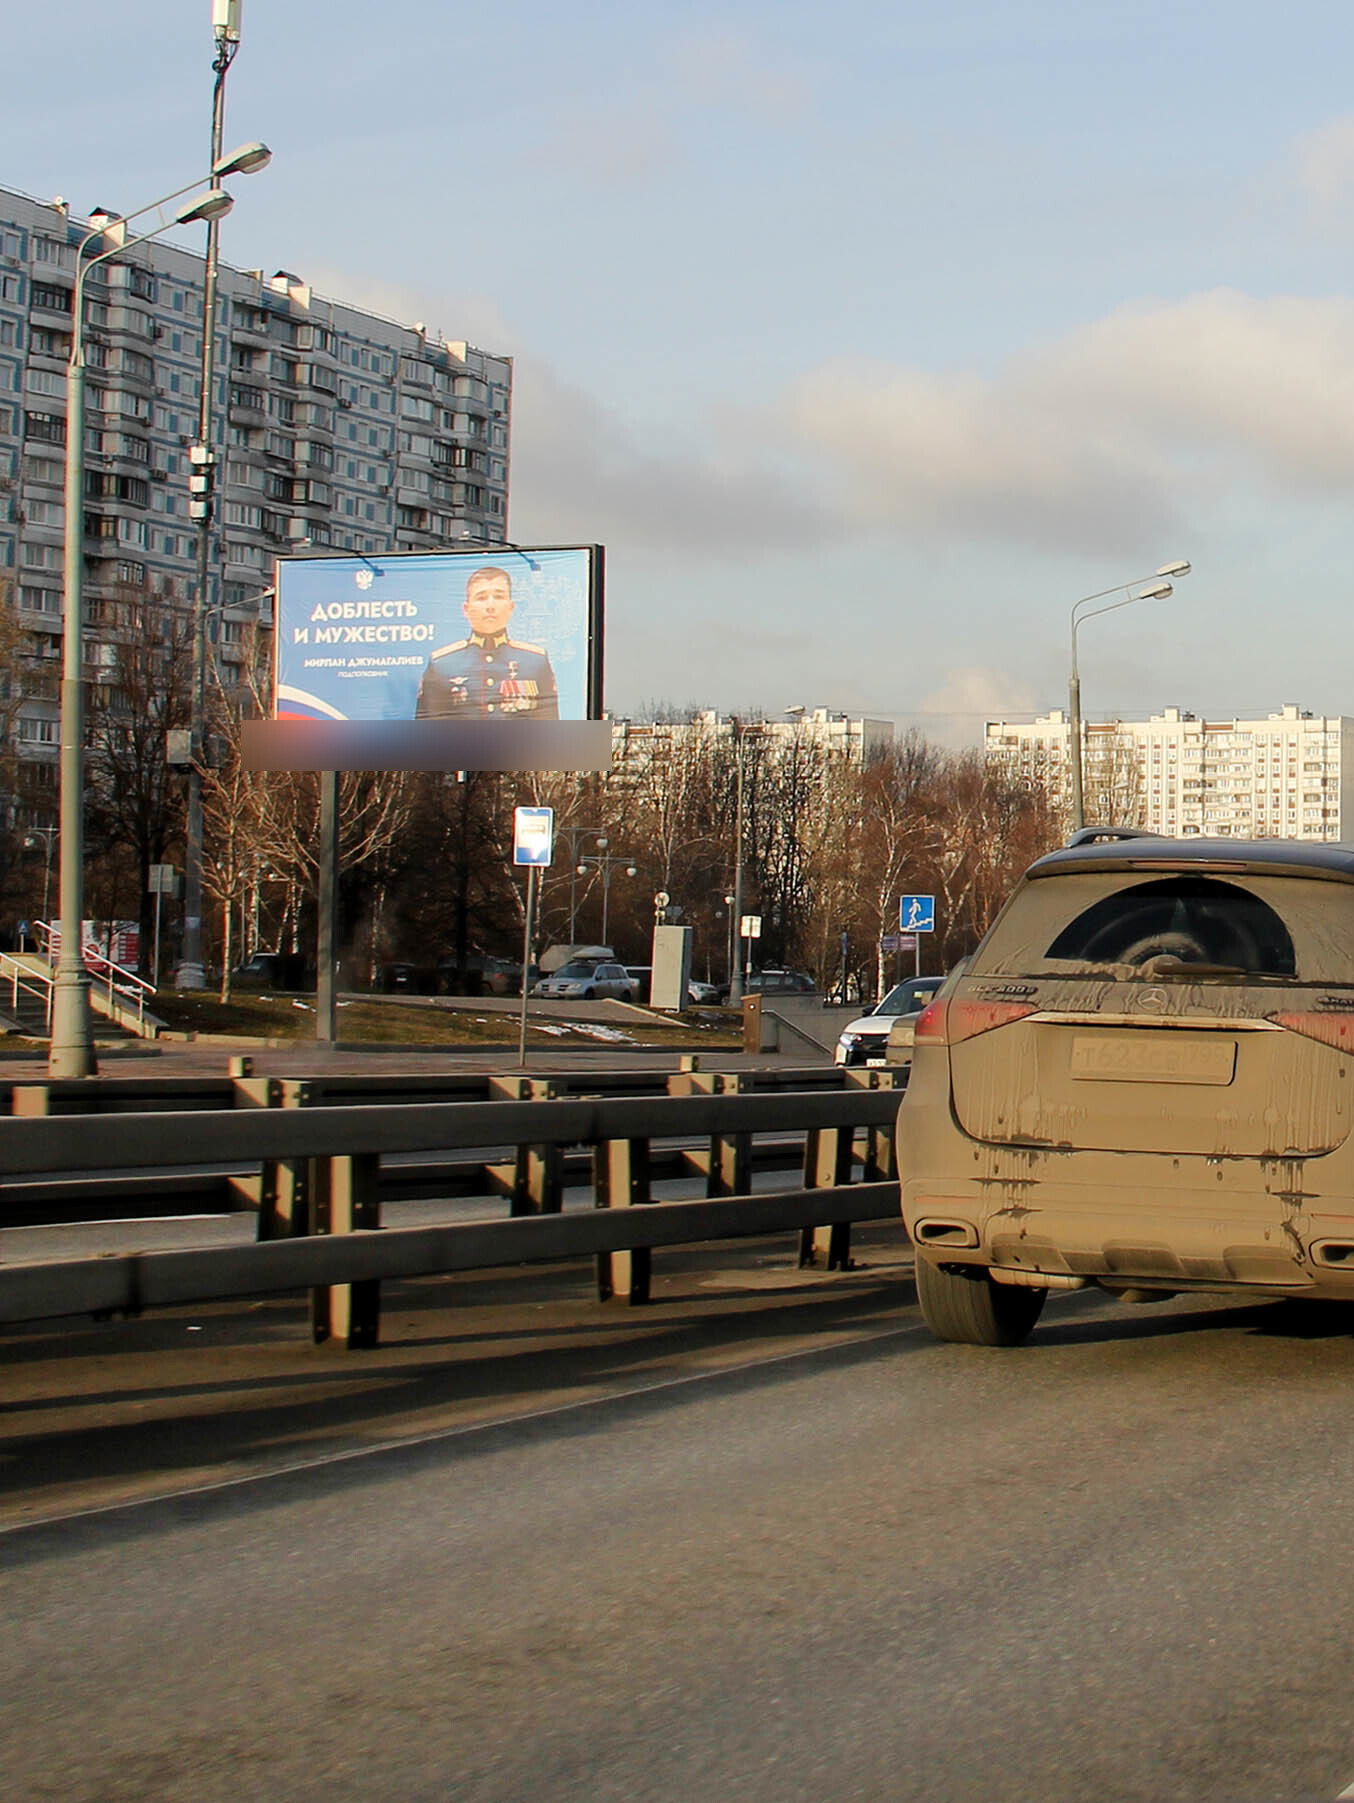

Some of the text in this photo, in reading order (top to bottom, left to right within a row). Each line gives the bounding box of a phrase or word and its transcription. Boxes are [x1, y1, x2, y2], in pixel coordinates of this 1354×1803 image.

[310, 600, 418, 622] ДОБЛЕСТЬ
[293, 623, 435, 644] И МУЖЕСТВО!
